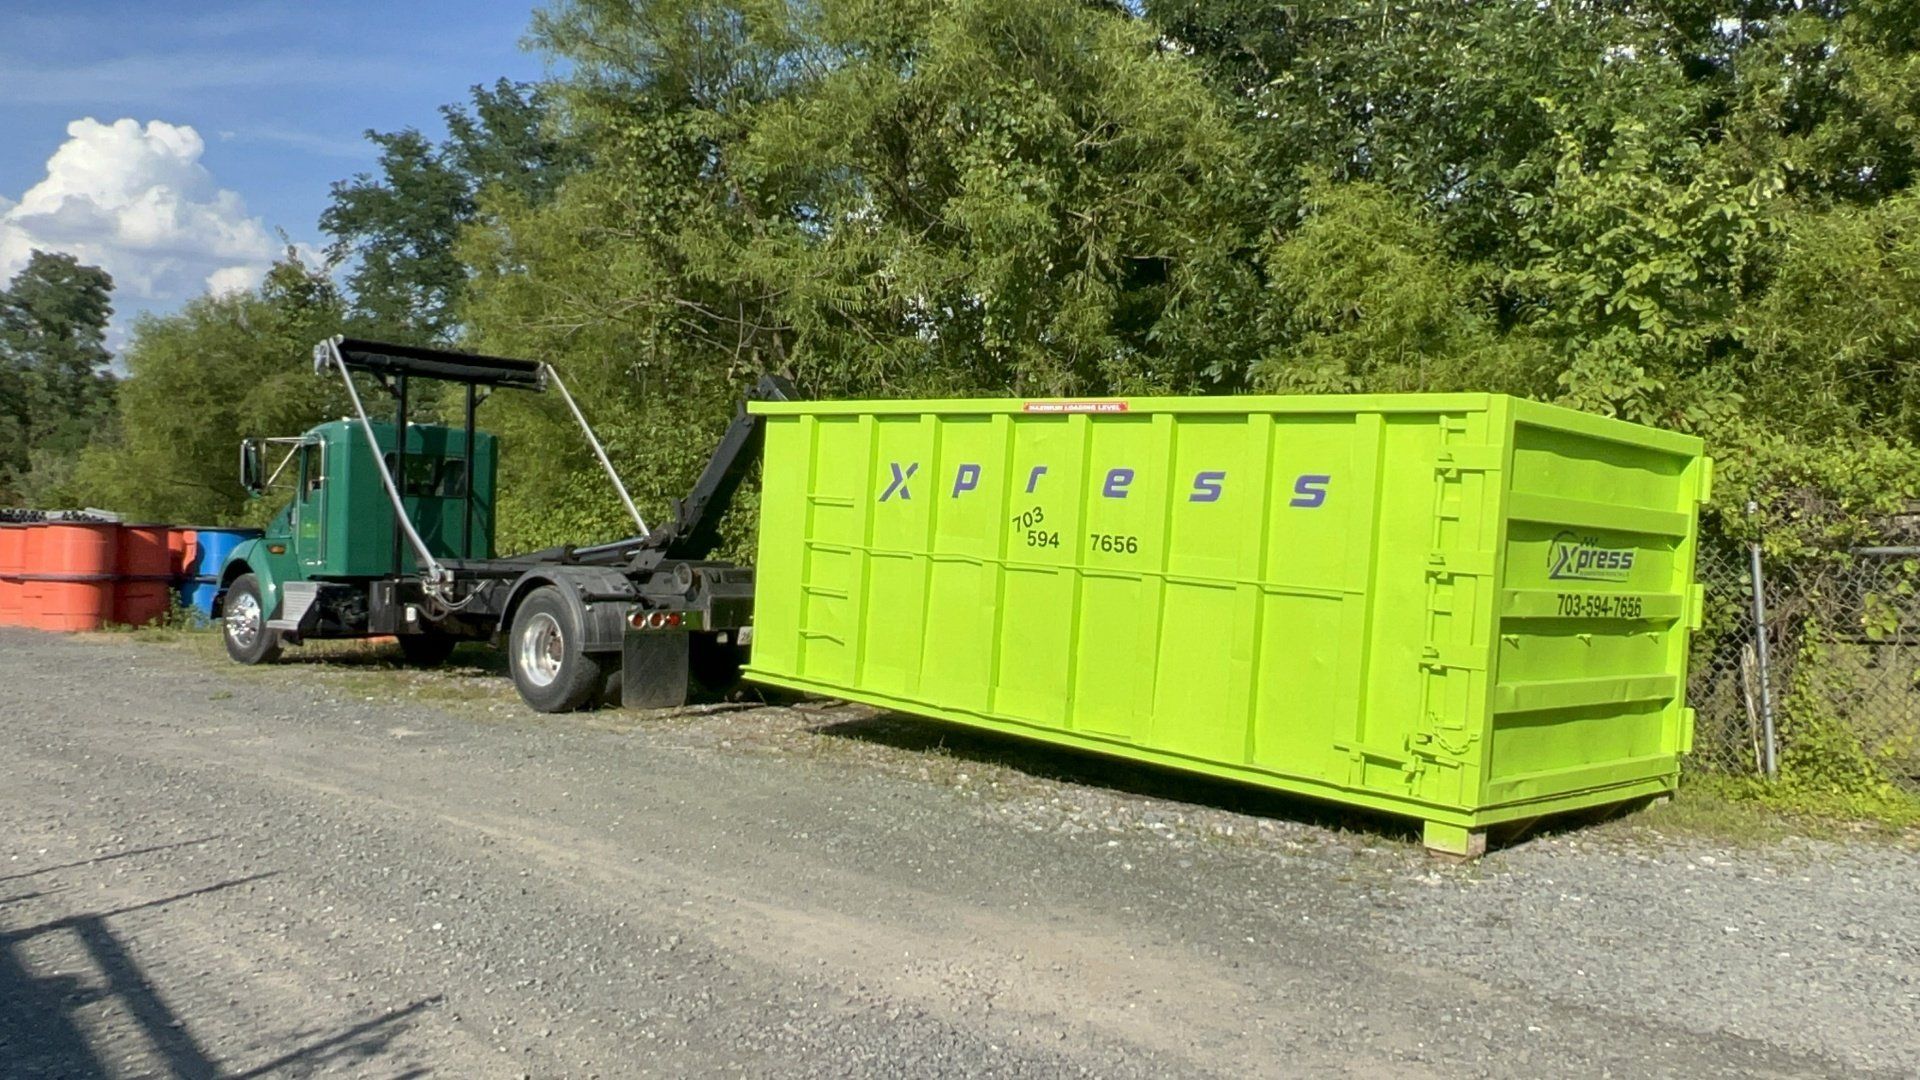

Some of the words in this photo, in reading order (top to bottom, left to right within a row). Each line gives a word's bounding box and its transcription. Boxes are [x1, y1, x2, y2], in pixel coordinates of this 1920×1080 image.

[1012, 506, 1045, 533] 703
[1026, 530, 1060, 549] 594
[1089, 534, 1138, 554] 7656
[1549, 544, 1634, 579] Xpress
[1557, 594, 1642, 617] 703-594-7656
